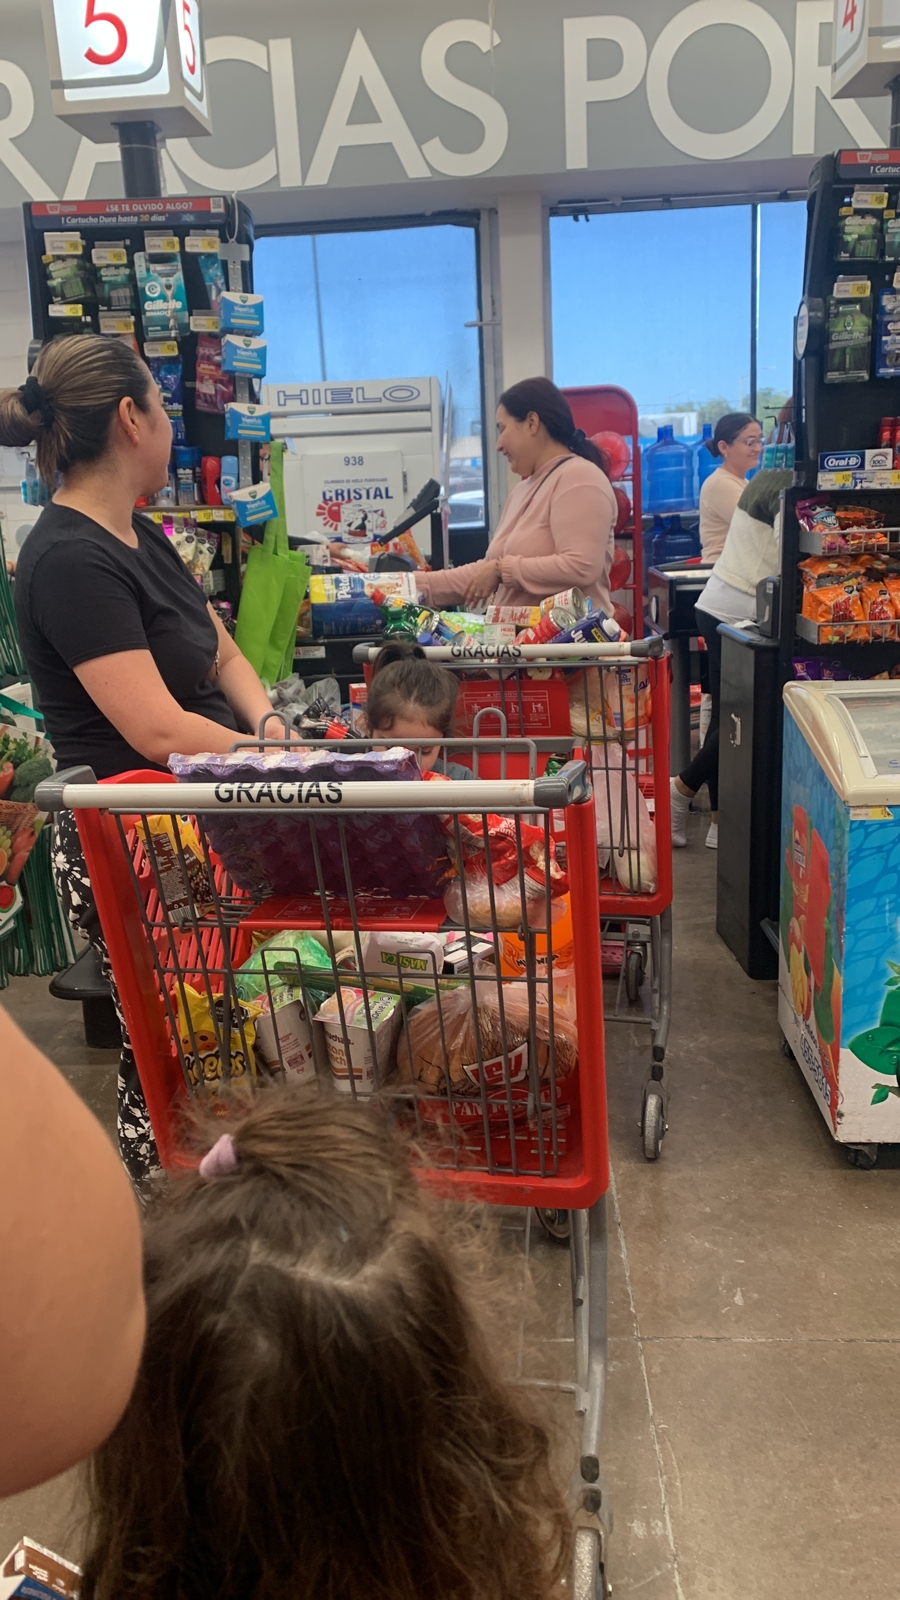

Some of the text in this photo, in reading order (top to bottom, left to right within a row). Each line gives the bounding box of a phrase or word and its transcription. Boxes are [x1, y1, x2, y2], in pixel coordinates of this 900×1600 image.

[841, 0, 858, 33] 4
[84, 0, 128, 65] 5
[182, 0, 196, 76] 5
[875, 165, 900, 174] Cartuc
[105, 201, 193, 212] ¿SE TE OLVIDÓ ALGO?
[66, 215, 98, 224] Cartucho
[99, 215, 116, 223] Dura
[118, 214, 138, 223] hasta
[139, 214, 149, 222] 30
[144, 299, 182, 311] Gillette
[832, 330, 865, 341] Gillette
[277, 385, 420, 407] HIELO
[343, 455, 364, 466] 938
[827, 456, 859, 467] Oral-B
[322, 486, 394, 502] CRISTAL
[450, 644, 522, 659] GRACIAS
[213, 781, 344, 805] GRACIAS
